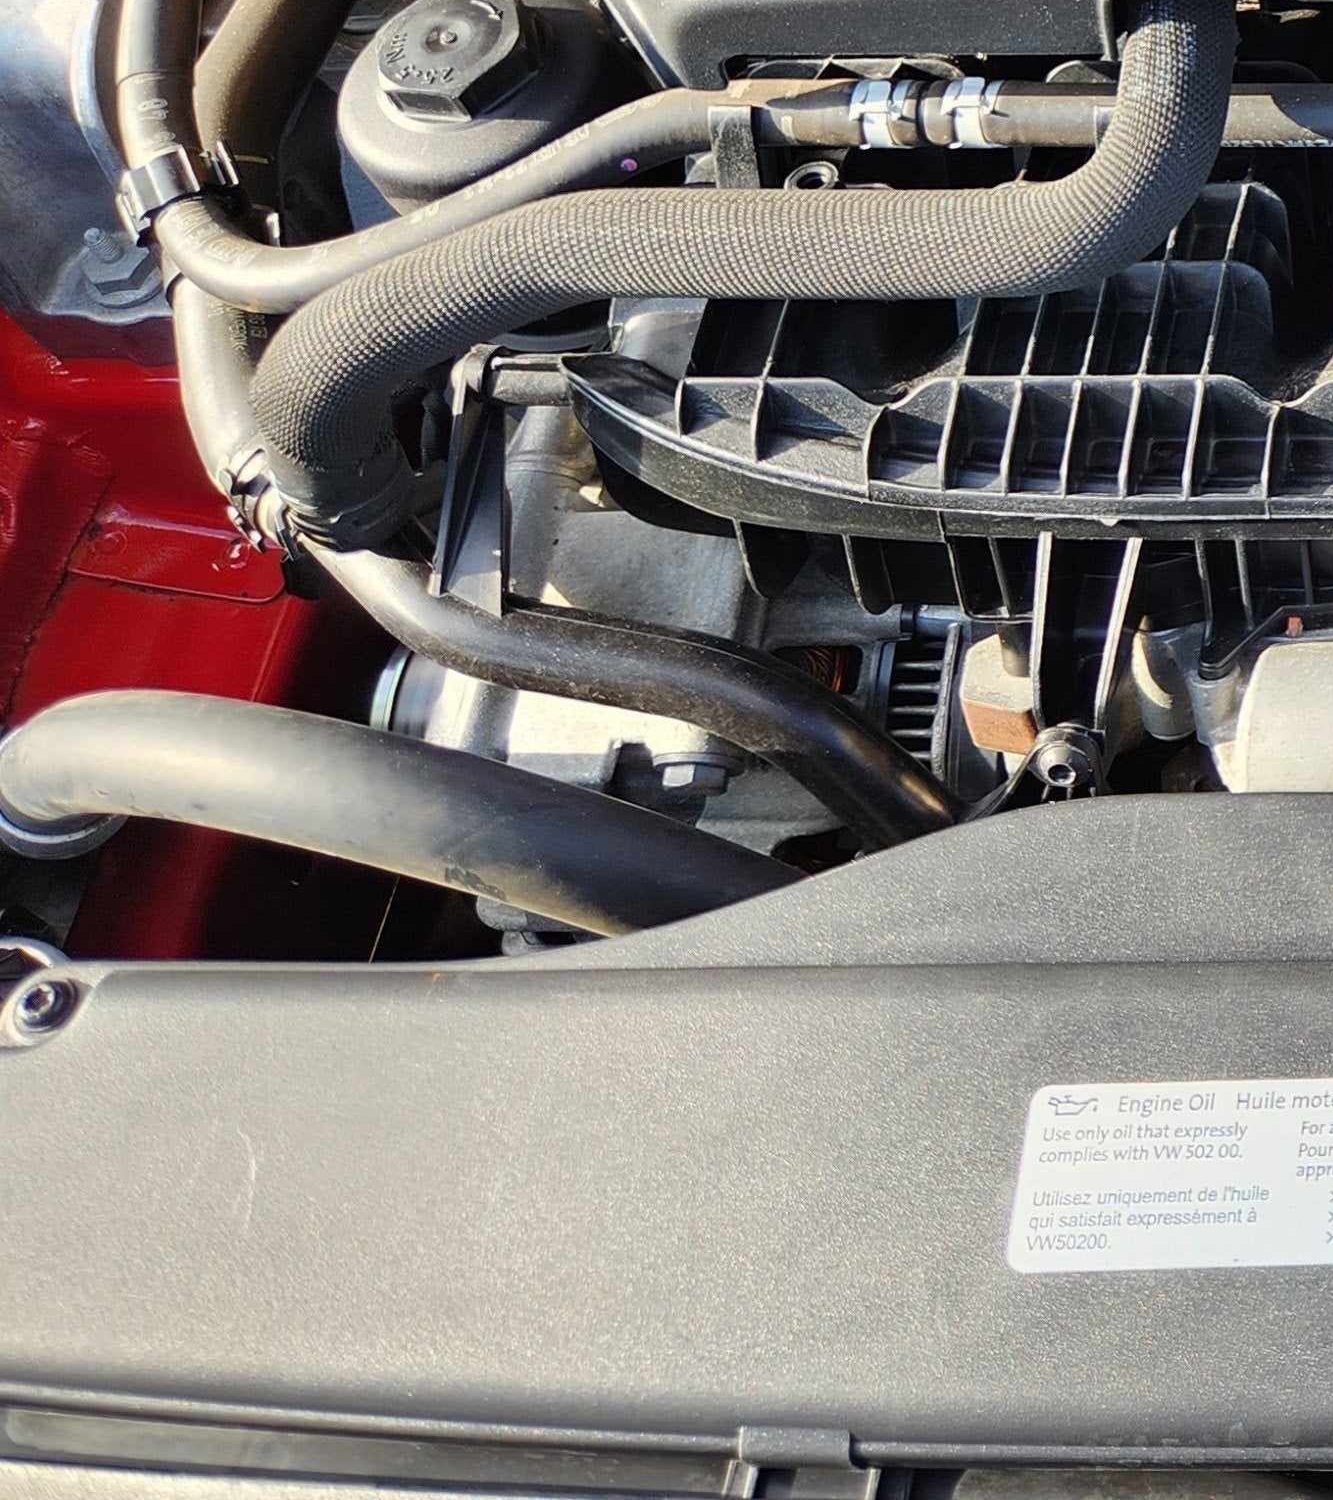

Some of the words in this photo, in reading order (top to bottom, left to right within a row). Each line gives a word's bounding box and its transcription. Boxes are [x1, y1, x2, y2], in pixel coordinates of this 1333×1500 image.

[1118, 1094, 1183, 1118] Engine
[1188, 1092, 1216, 1111] Oil
[1236, 1091, 1286, 1110] Huile
[1043, 1127, 1071, 1142] Use
[1074, 1124, 1110, 1145] only
[1112, 1123, 1133, 1140] oil
[1136, 1123, 1171, 1139] that
[1174, 1121, 1248, 1143] expressly
[1300, 1120, 1327, 1136] For
[1038, 1146, 1109, 1167] complies
[1113, 1145, 1149, 1161] with
[1153, 1145, 1183, 1160] VW
[1185, 1144, 1214, 1159] 502
[1217, 1143, 1243, 1158] 00.
[1032, 1190, 1092, 1207] Utilisez
[1096, 1188, 1193, 1208] uniquement
[1196, 1186, 1218, 1202] de
[1222, 1185, 1270, 1202] l'huile
[1029, 1212, 1054, 1232] qui
[1058, 1210, 1122, 1228] satisfait
[1126, 1208, 1243, 1230] expressément
[1246, 1207, 1258, 1223] à
[1026, 1233, 1112, 1251] VW50200.
